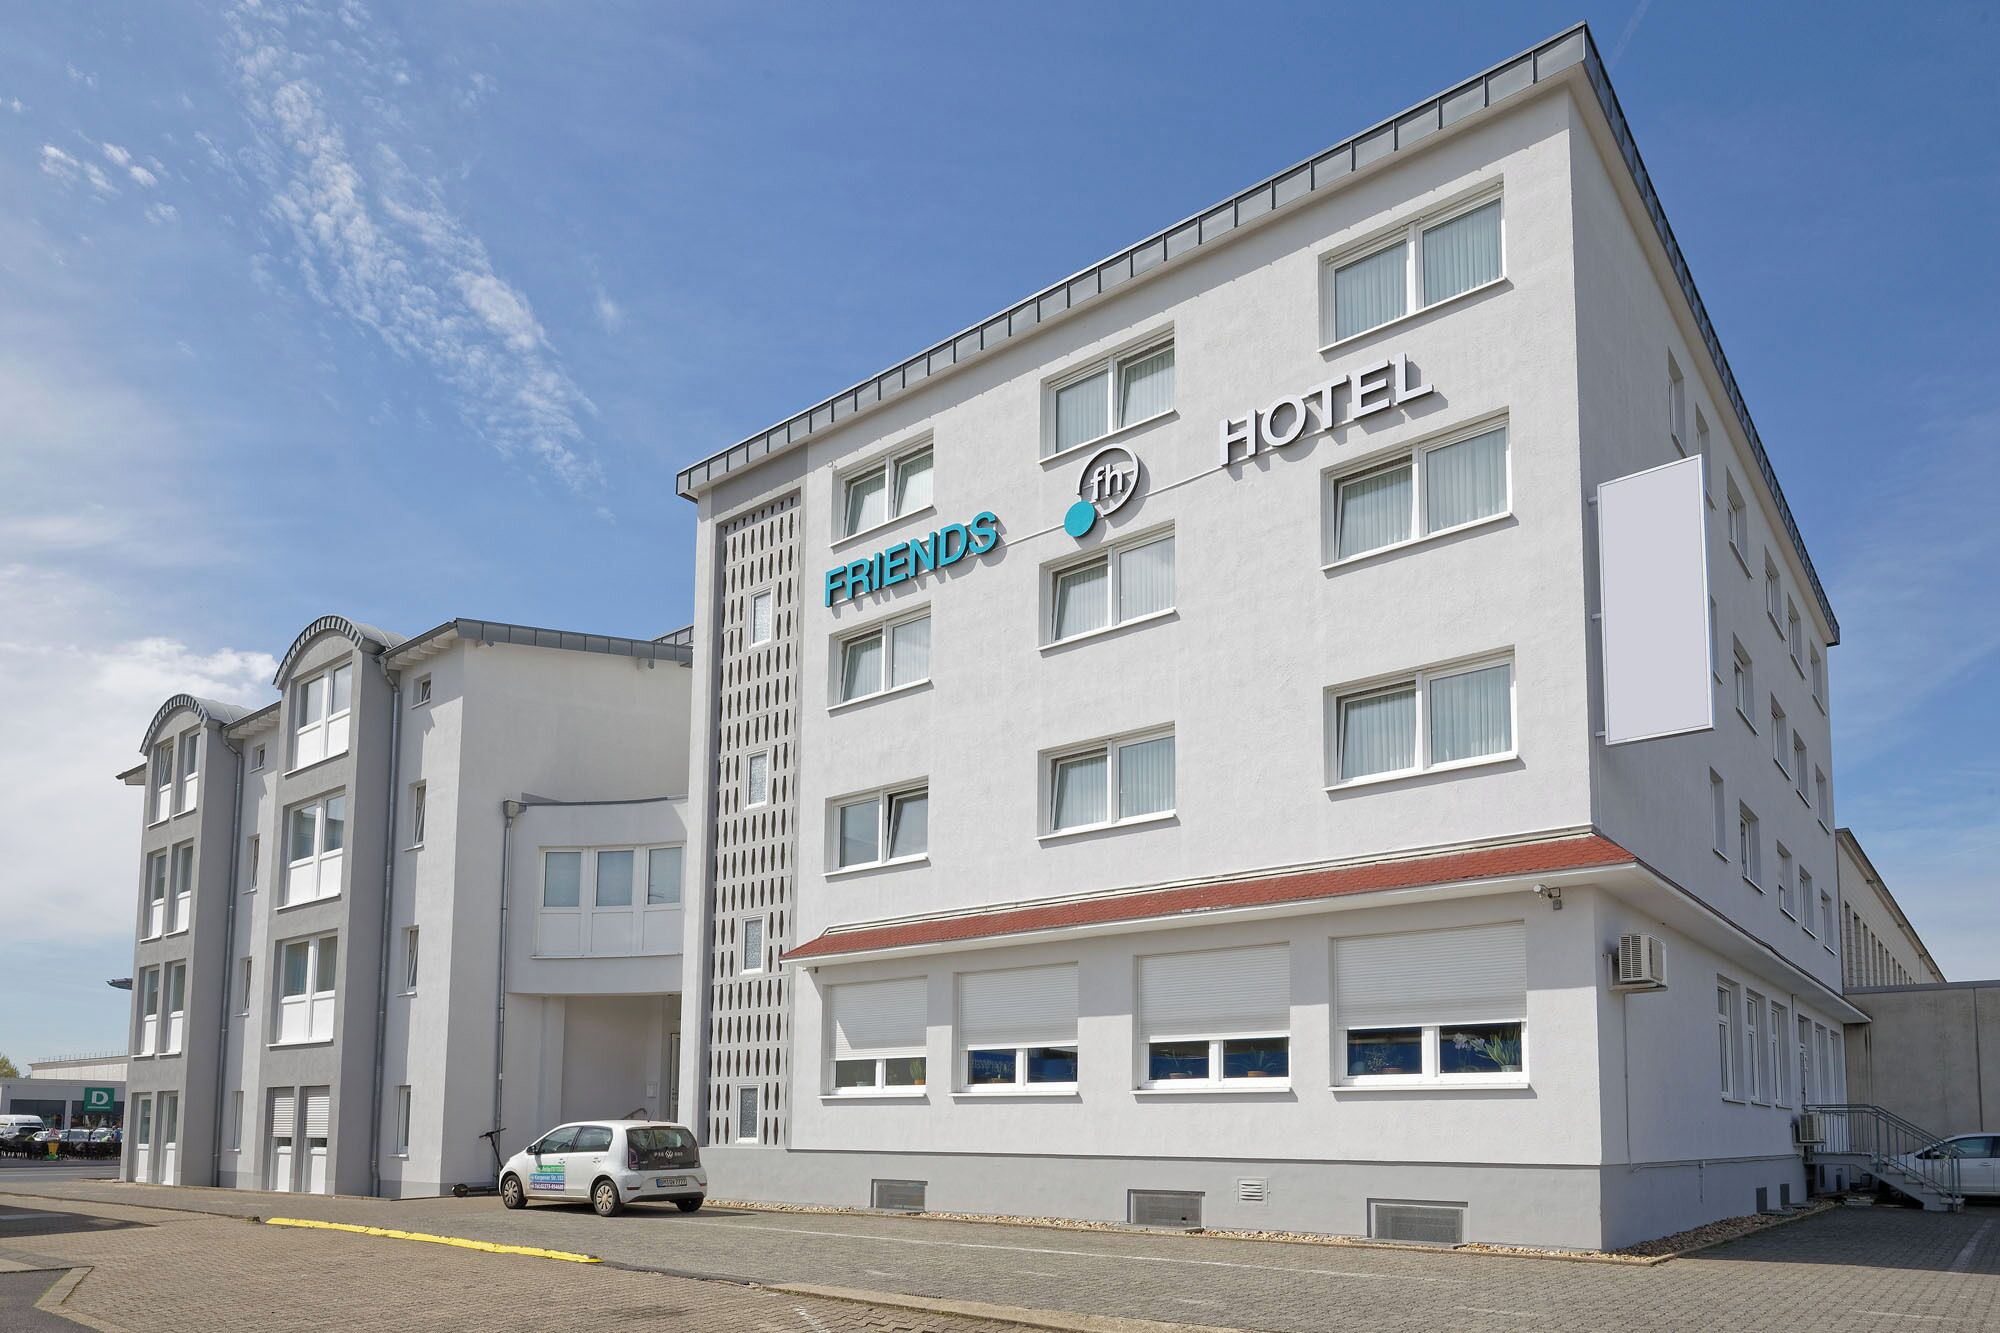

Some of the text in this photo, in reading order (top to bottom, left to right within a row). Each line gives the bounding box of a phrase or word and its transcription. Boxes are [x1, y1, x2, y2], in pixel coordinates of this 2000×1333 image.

[1219, 351, 1434, 466] HOTEL
[1090, 463, 1124, 501] fh
[825, 511, 999, 608] FRIENDS
[92, 1091, 108, 1105] D
